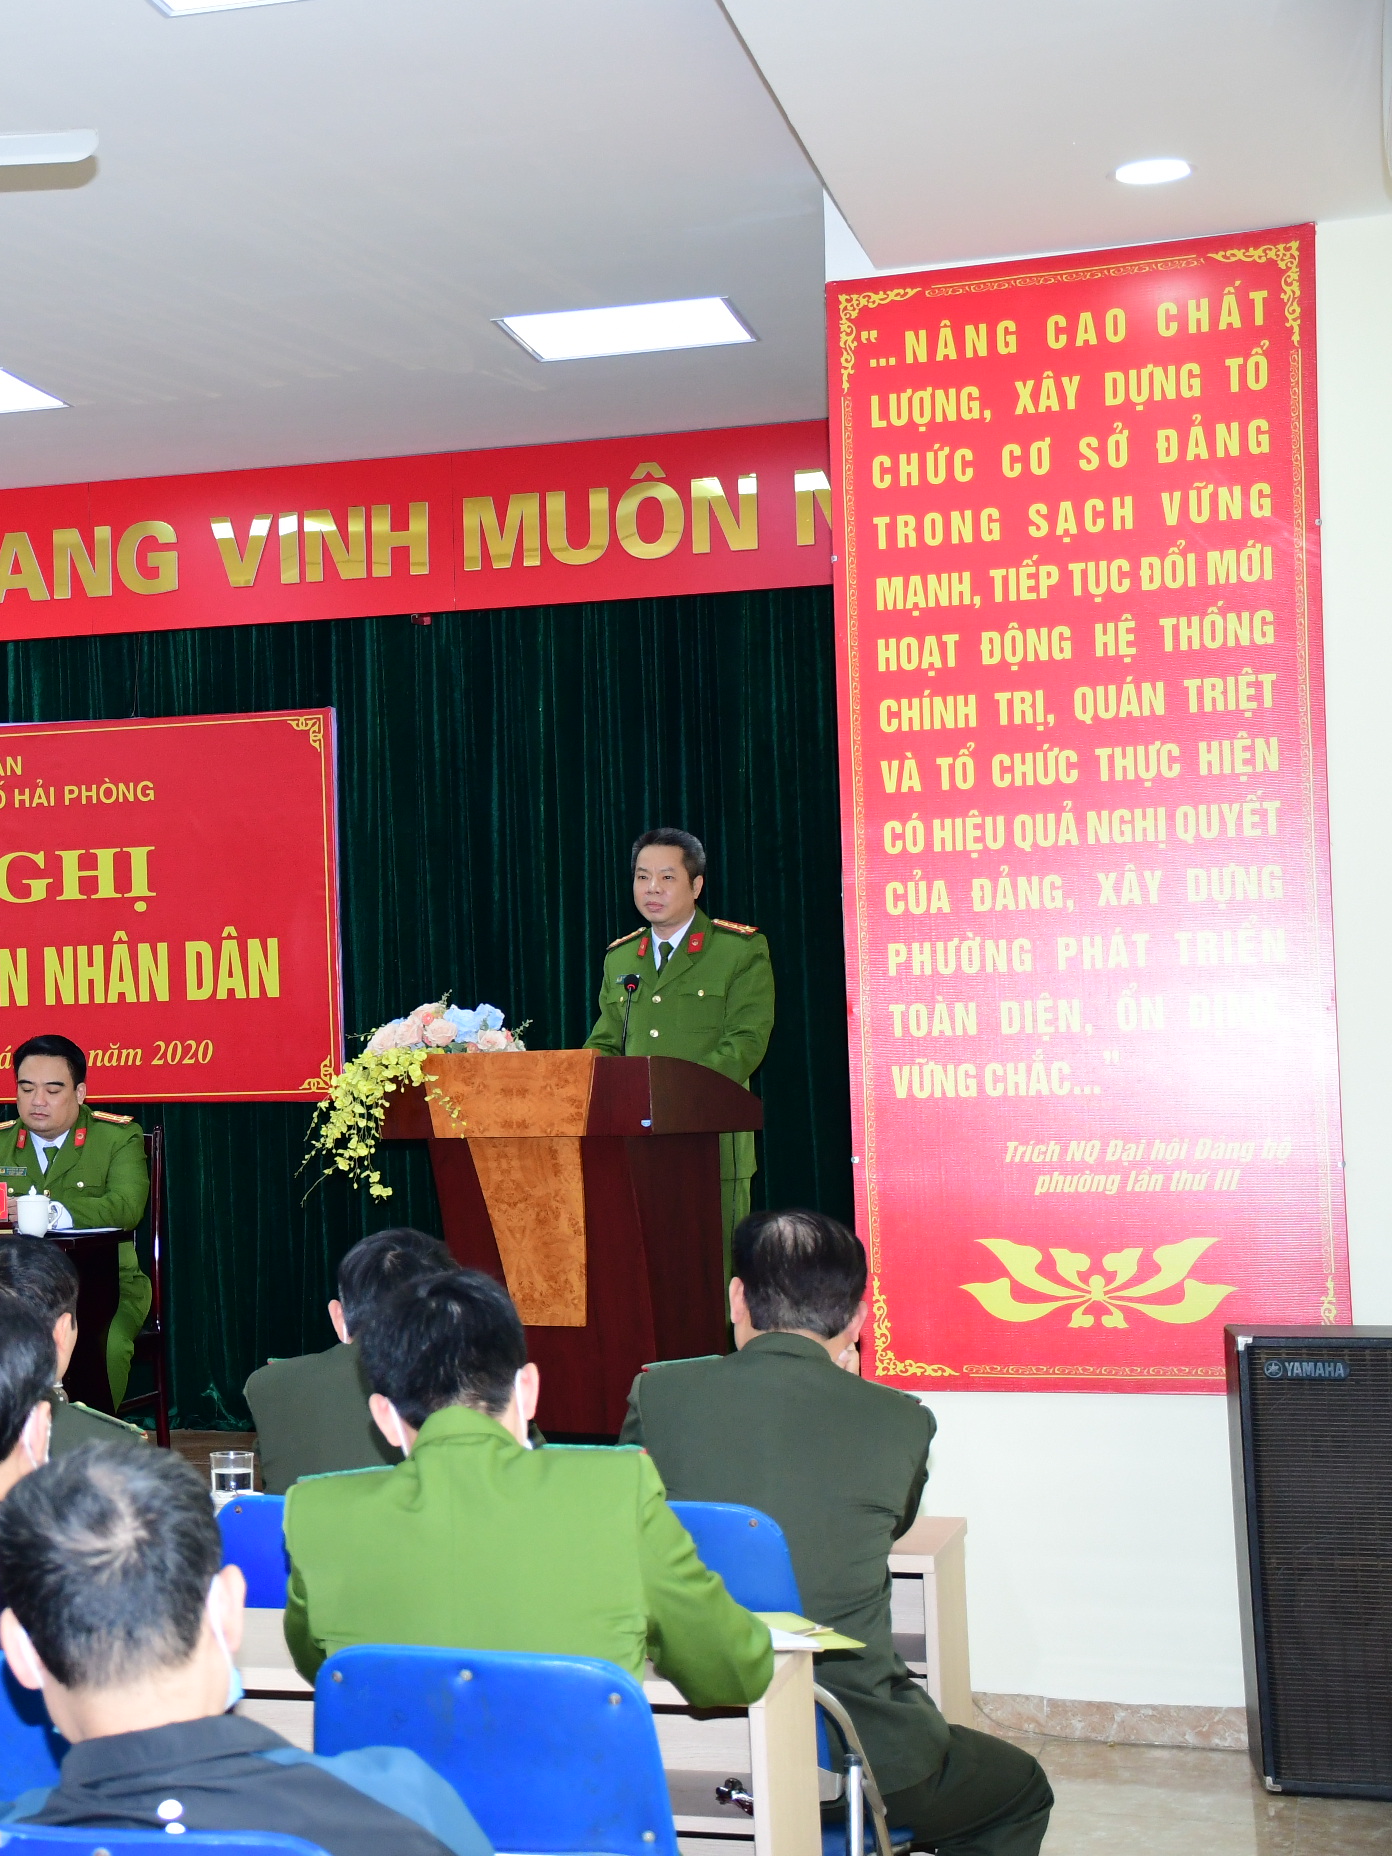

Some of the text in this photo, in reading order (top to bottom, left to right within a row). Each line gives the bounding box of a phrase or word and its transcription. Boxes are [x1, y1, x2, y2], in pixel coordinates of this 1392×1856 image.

[1047, 308, 1126, 349] CAO
[1154, 281, 1267, 337] CHẤT
[871, 340, 1269, 431] LƯỢNG, XÂY DỰNG TỔ
[873, 414, 1269, 488] CHỨC CƠ SỞ ĐẢNG
[210, 501, 430, 588] VINH
[462, 461, 760, 572] MUÔN
[873, 482, 1271, 549] TRONG SẠCH VỮNG
[876, 540, 1272, 616] MẠNH, TIẾP TỤC ĐỔI MỚI
[878, 601, 1274, 676] HOẠT ĐỘNG HỆ THỐNG
[880, 668, 1276, 732] CHÍNH TRỊ, QUÁN TRIỆT
[15, 779, 54, 807] HẢI
[65, 778, 154, 805] PHÒNG
[881, 731, 1280, 793] VÀ TỔ CHỨC THỰC HIỆN
[884, 791, 1282, 858] CÓ HIỆU QUẢ NGHỊ QUYẾT
[885, 862, 1284, 916] CỦA ĐẢNG, XÂY DỰNG
[44, 931, 169, 1005] NHÂN
[185, 926, 279, 1000] DÂN
[887, 915, 1287, 978] PHƯỜNG PHÁT TRIỂN
[888, 996, 977, 1037] TOÀN
[1000, 992, 1094, 1042] DIỆN,
[1116, 982, 1164, 1031] ỔN
[88, 1043, 142, 1066] năm
[151, 1040, 213, 1064] 2020
[891, 1055, 977, 1100] VỮNG
[1005, 1140, 1061, 1163] Trích
[1066, 1140, 1100, 1164] NQ
[1106, 1139, 1146, 1166] Đại
[1150, 1138, 1189, 1164] hội
[1034, 1170, 1121, 1195] phường
[1126, 1167, 1163, 1192] lần
[1170, 1170, 1210, 1191] thứ
[1285, 1362, 1344, 1377] YAMAHA
